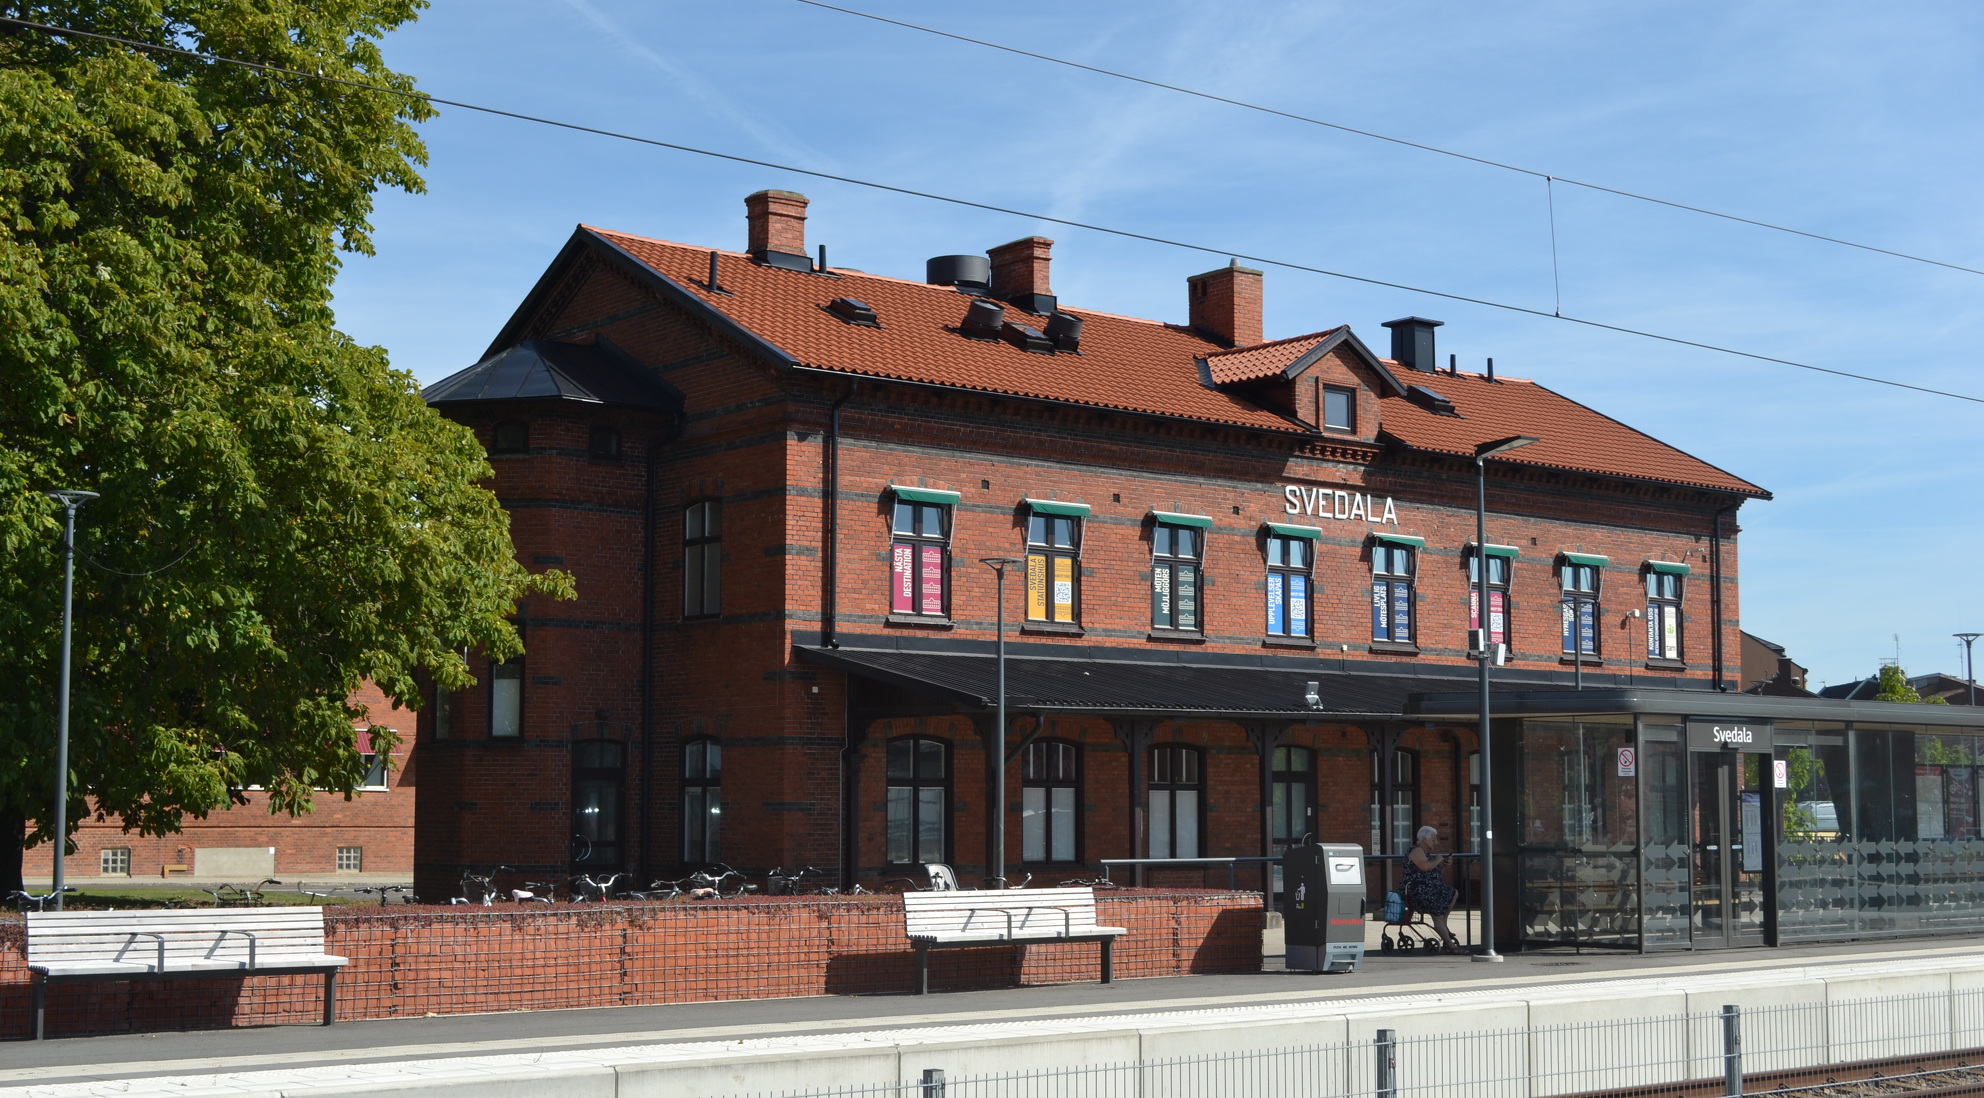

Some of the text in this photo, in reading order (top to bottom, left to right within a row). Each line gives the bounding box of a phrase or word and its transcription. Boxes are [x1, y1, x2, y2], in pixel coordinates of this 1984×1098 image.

[1285, 485, 1398, 525] SVEDALA
[894, 548, 903, 572] NÄSTA
[903, 548, 912, 597] DESTINATION
[1154, 568, 1162, 592] MÖTEN
[1037, 558, 1045, 606] STATIONSHUS
[1161, 568, 1170, 614] MÖJLIGGÖRS
[1268, 577, 1276, 624] UPPLEVELSER
[1713, 726, 1752, 743] Svedala
